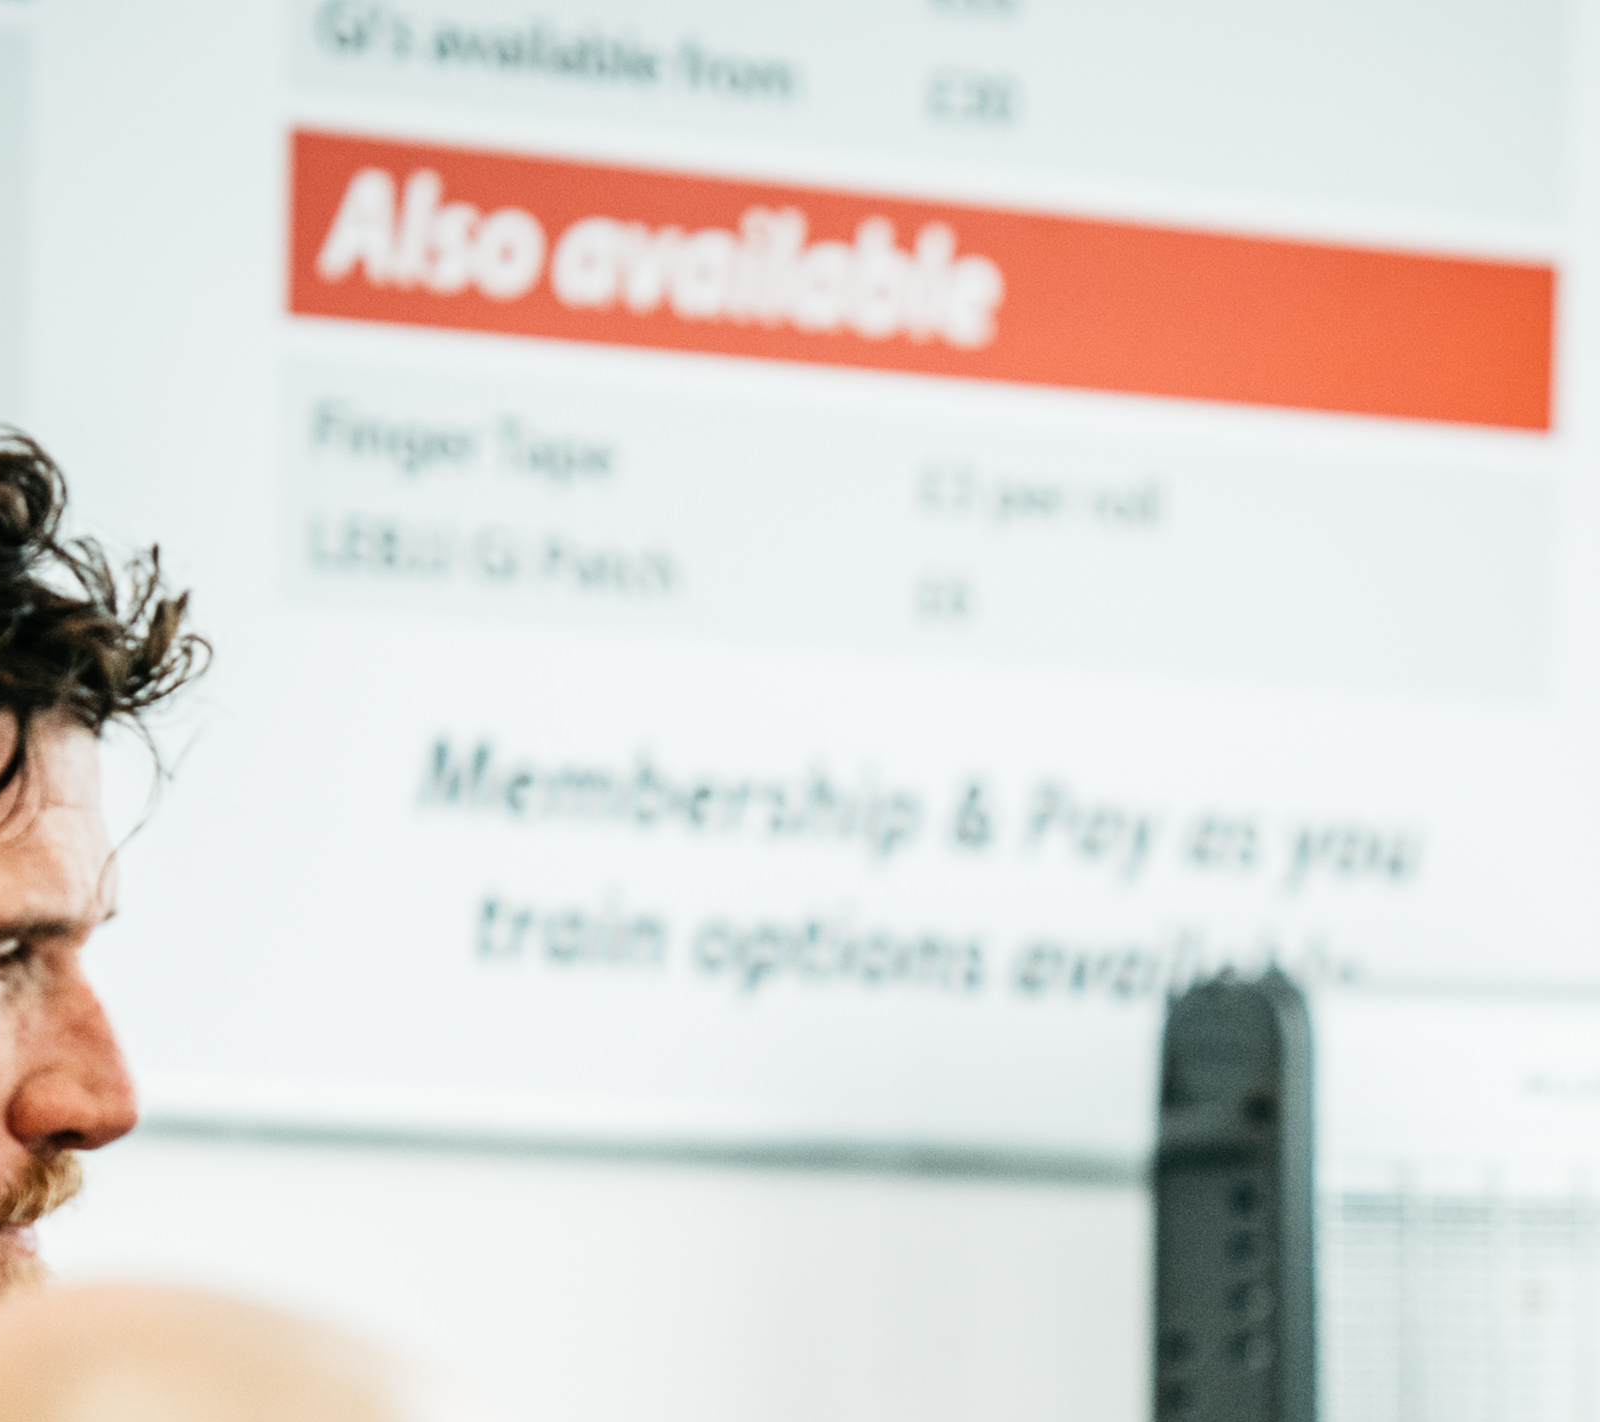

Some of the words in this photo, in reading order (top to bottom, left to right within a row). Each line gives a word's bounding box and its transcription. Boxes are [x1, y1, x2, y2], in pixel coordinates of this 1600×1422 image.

[316, 167, 549, 300] Also
[551, 207, 1006, 350] available
[417, 735, 924, 866] Membership
[952, 772, 998, 848] &
[1025, 782, 1159, 880] Pay
[1184, 812, 1262, 868] as
[1290, 818, 1424, 894] you
[474, 893, 668, 966] train
[692, 905, 988, 992] options
